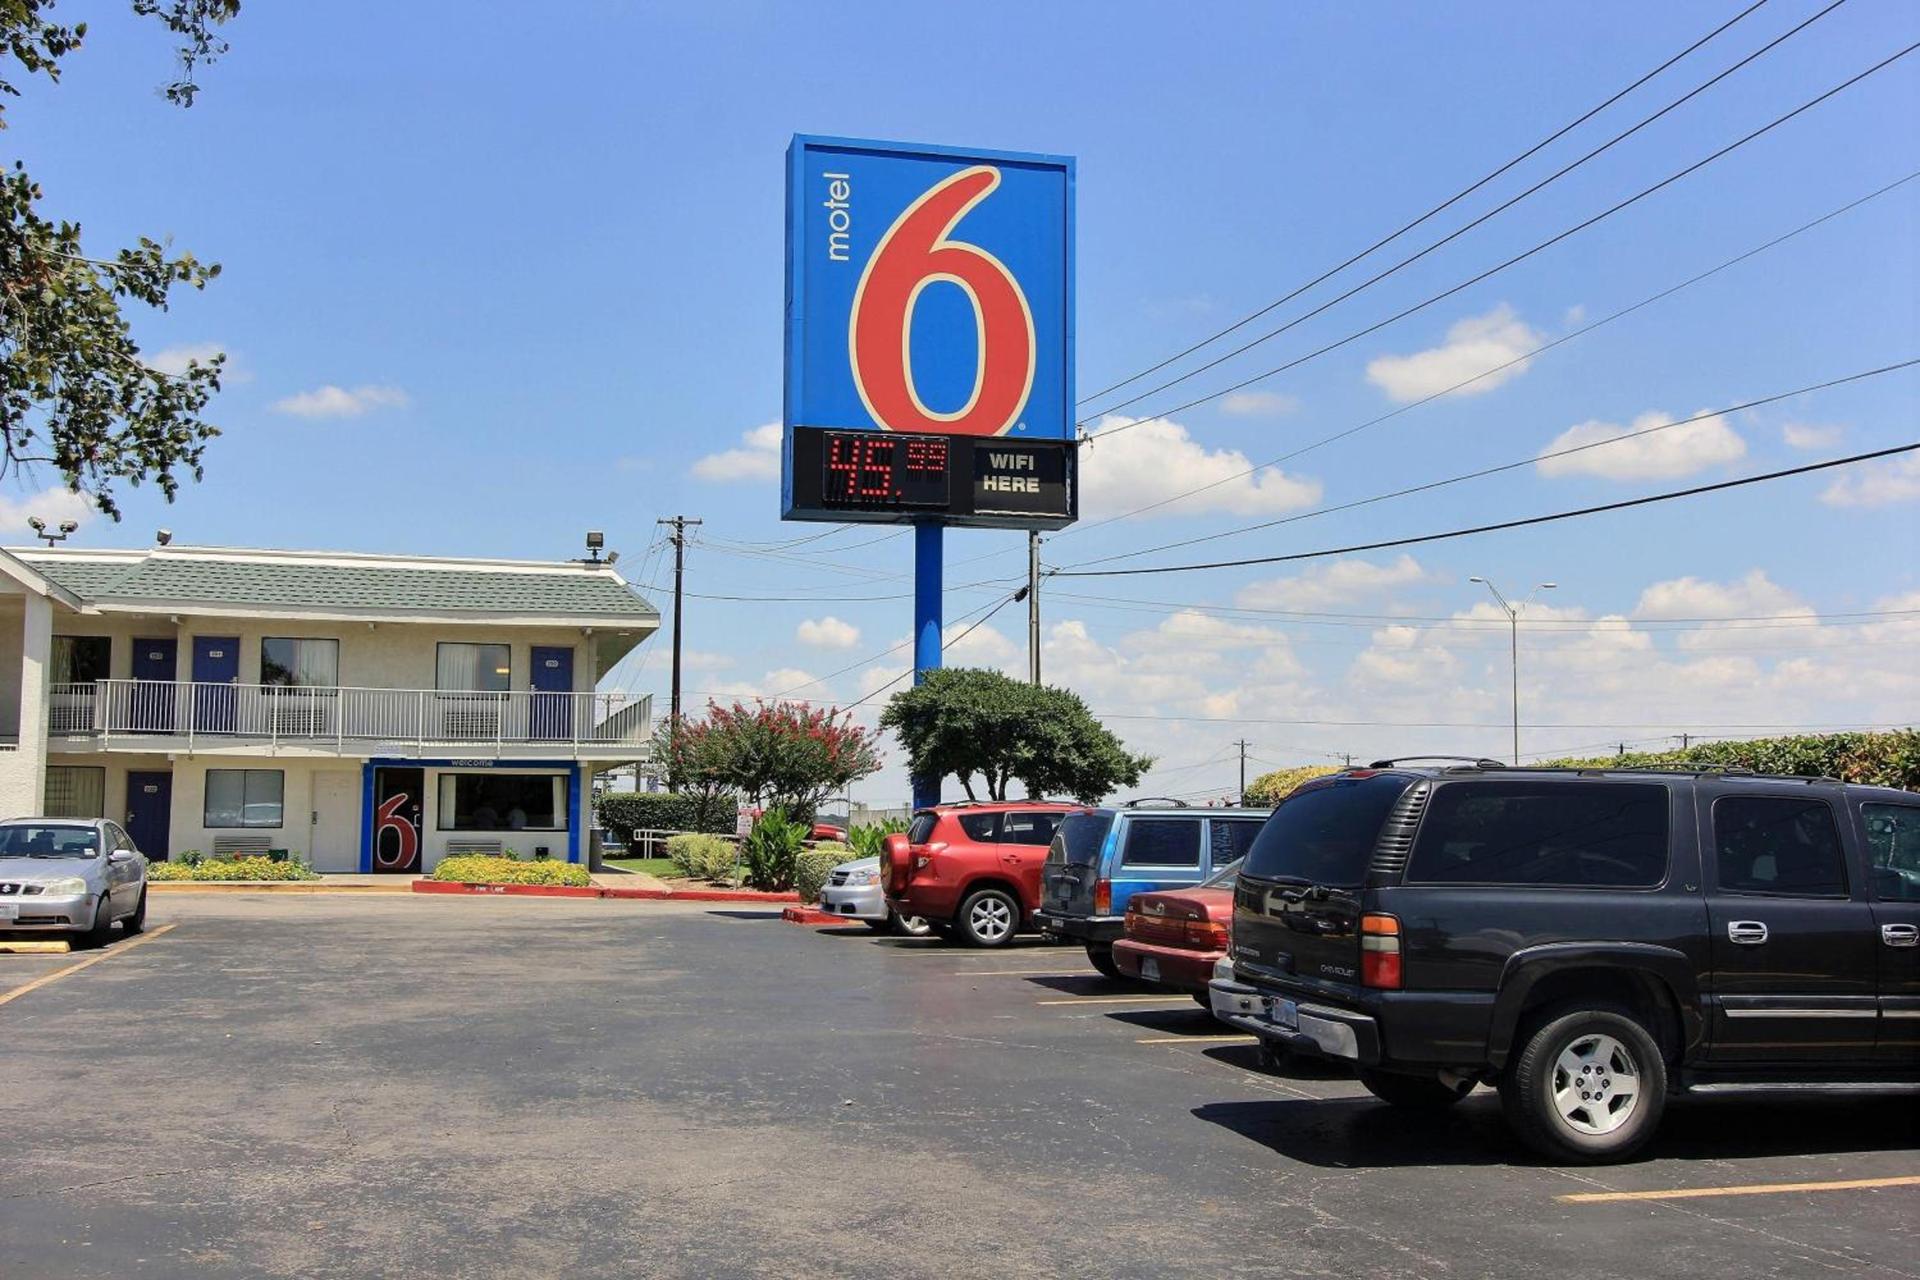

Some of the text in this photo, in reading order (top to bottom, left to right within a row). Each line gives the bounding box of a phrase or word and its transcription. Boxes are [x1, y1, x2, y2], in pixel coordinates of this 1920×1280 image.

[823, 172, 850, 261] motel
[848, 165, 1036, 437] 6
[989, 453, 1034, 471] WIFI
[983, 475, 1040, 494] HERE
[451, 759, 494, 767] welcome
